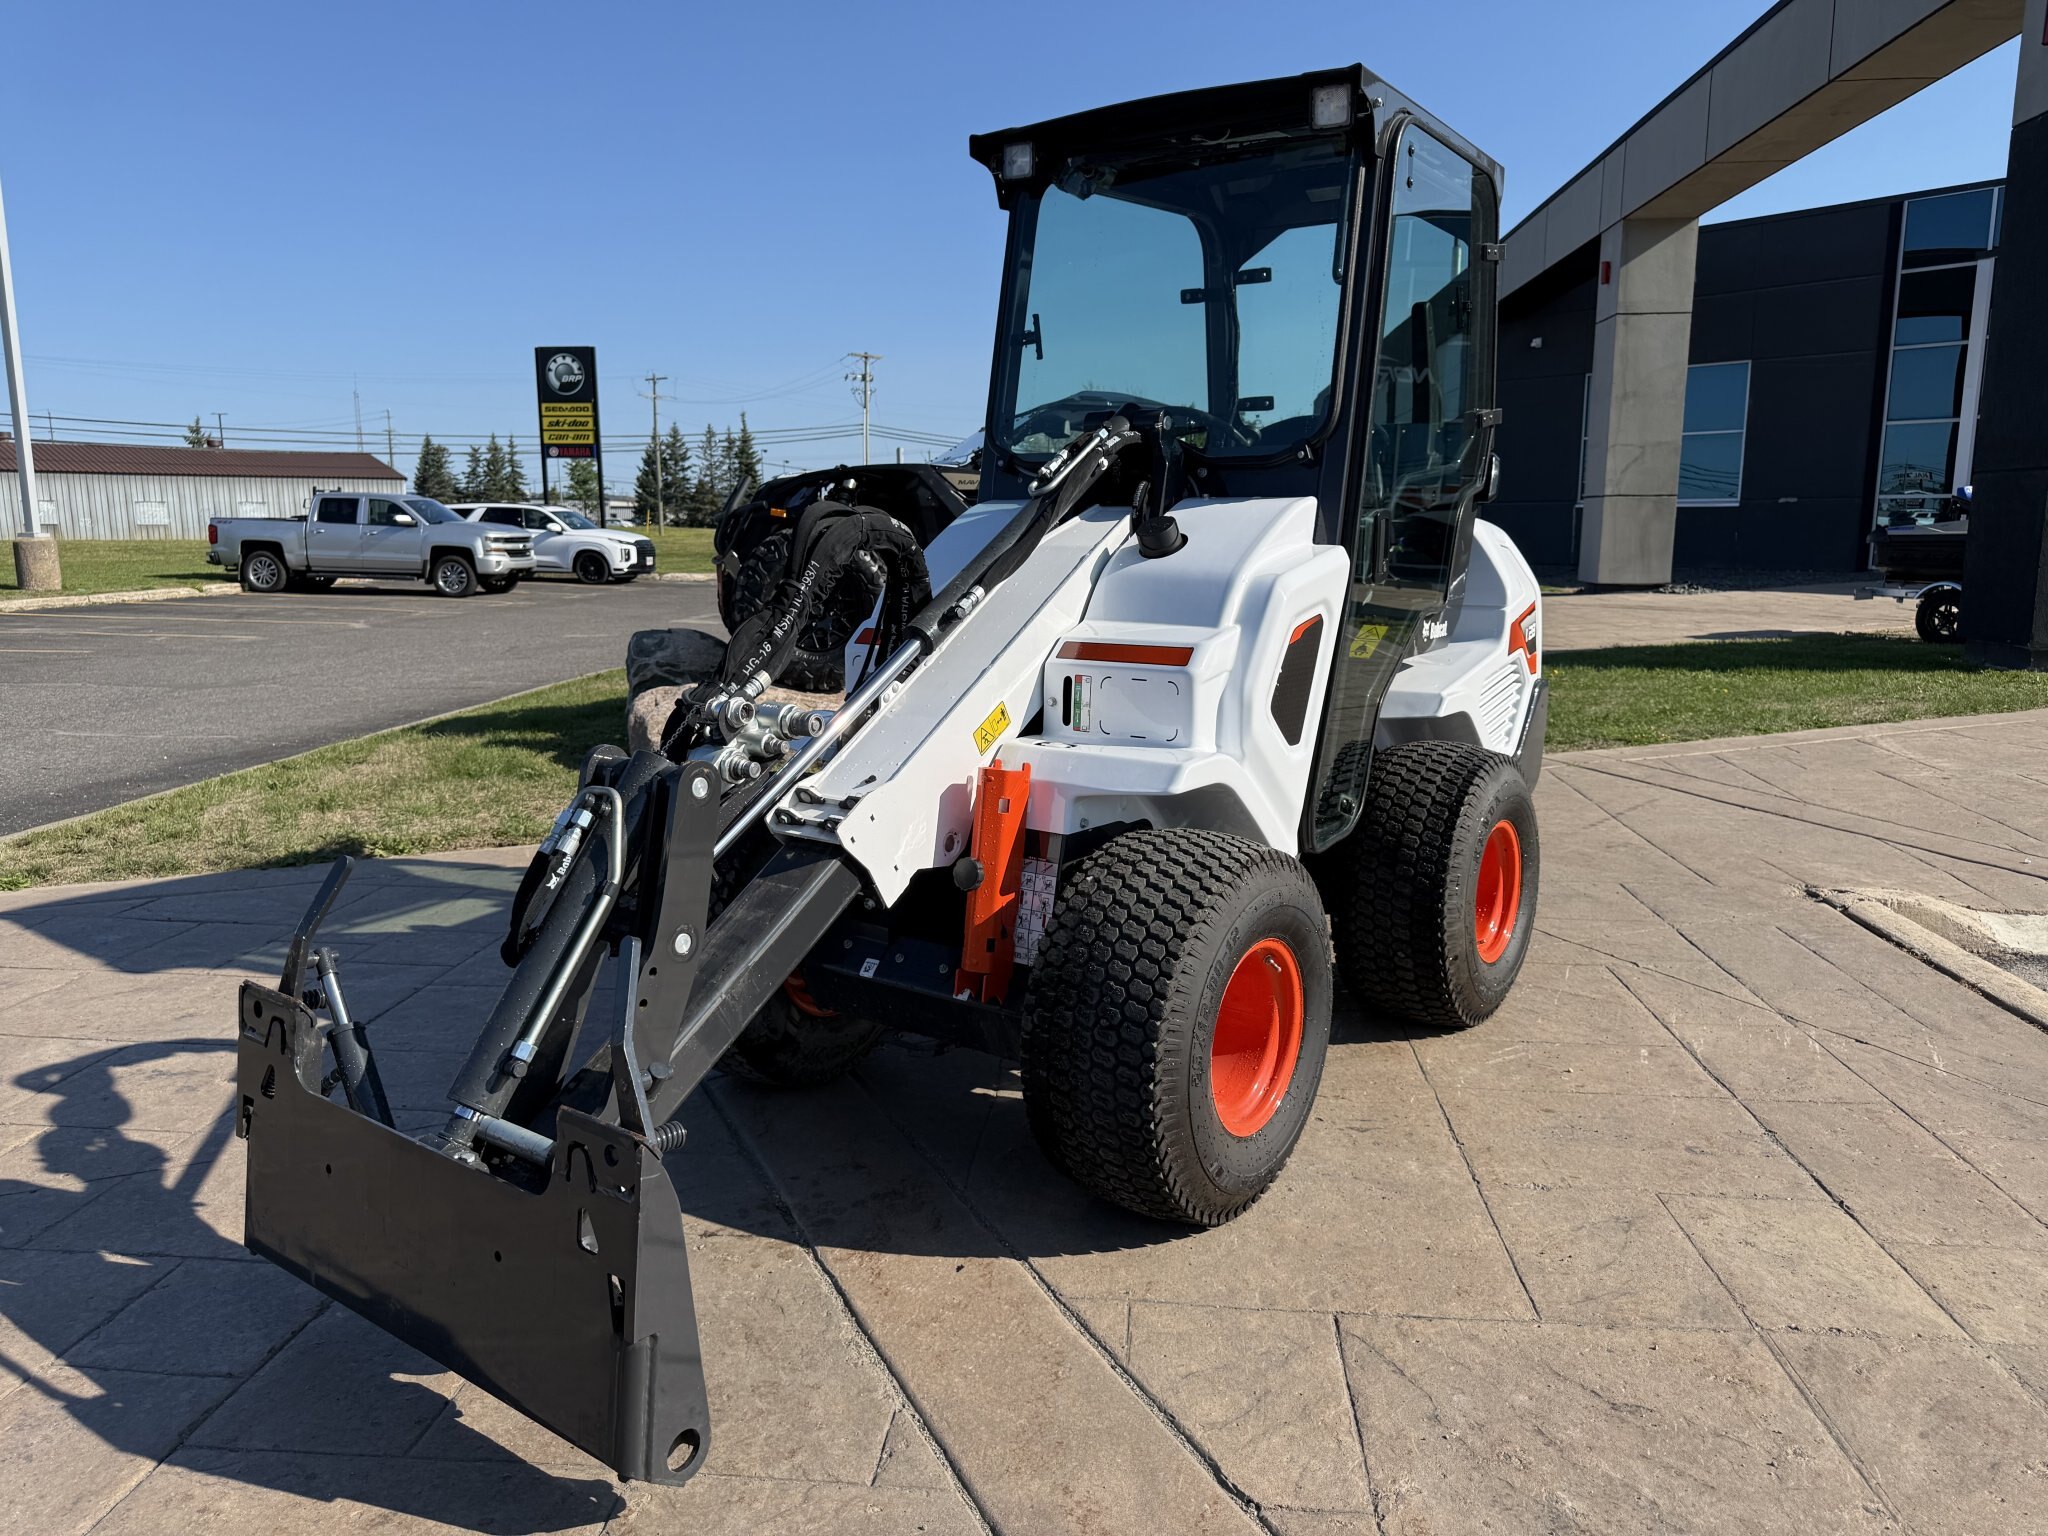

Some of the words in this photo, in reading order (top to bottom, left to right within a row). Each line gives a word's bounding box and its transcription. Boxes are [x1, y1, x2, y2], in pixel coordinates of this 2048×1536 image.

[561, 374, 582, 383] BRP
[547, 419, 590, 428] ski-doo
[548, 432, 591, 441] can-am
[559, 447, 592, 457] YAMAHA
[556, 853, 573, 876] Bob
